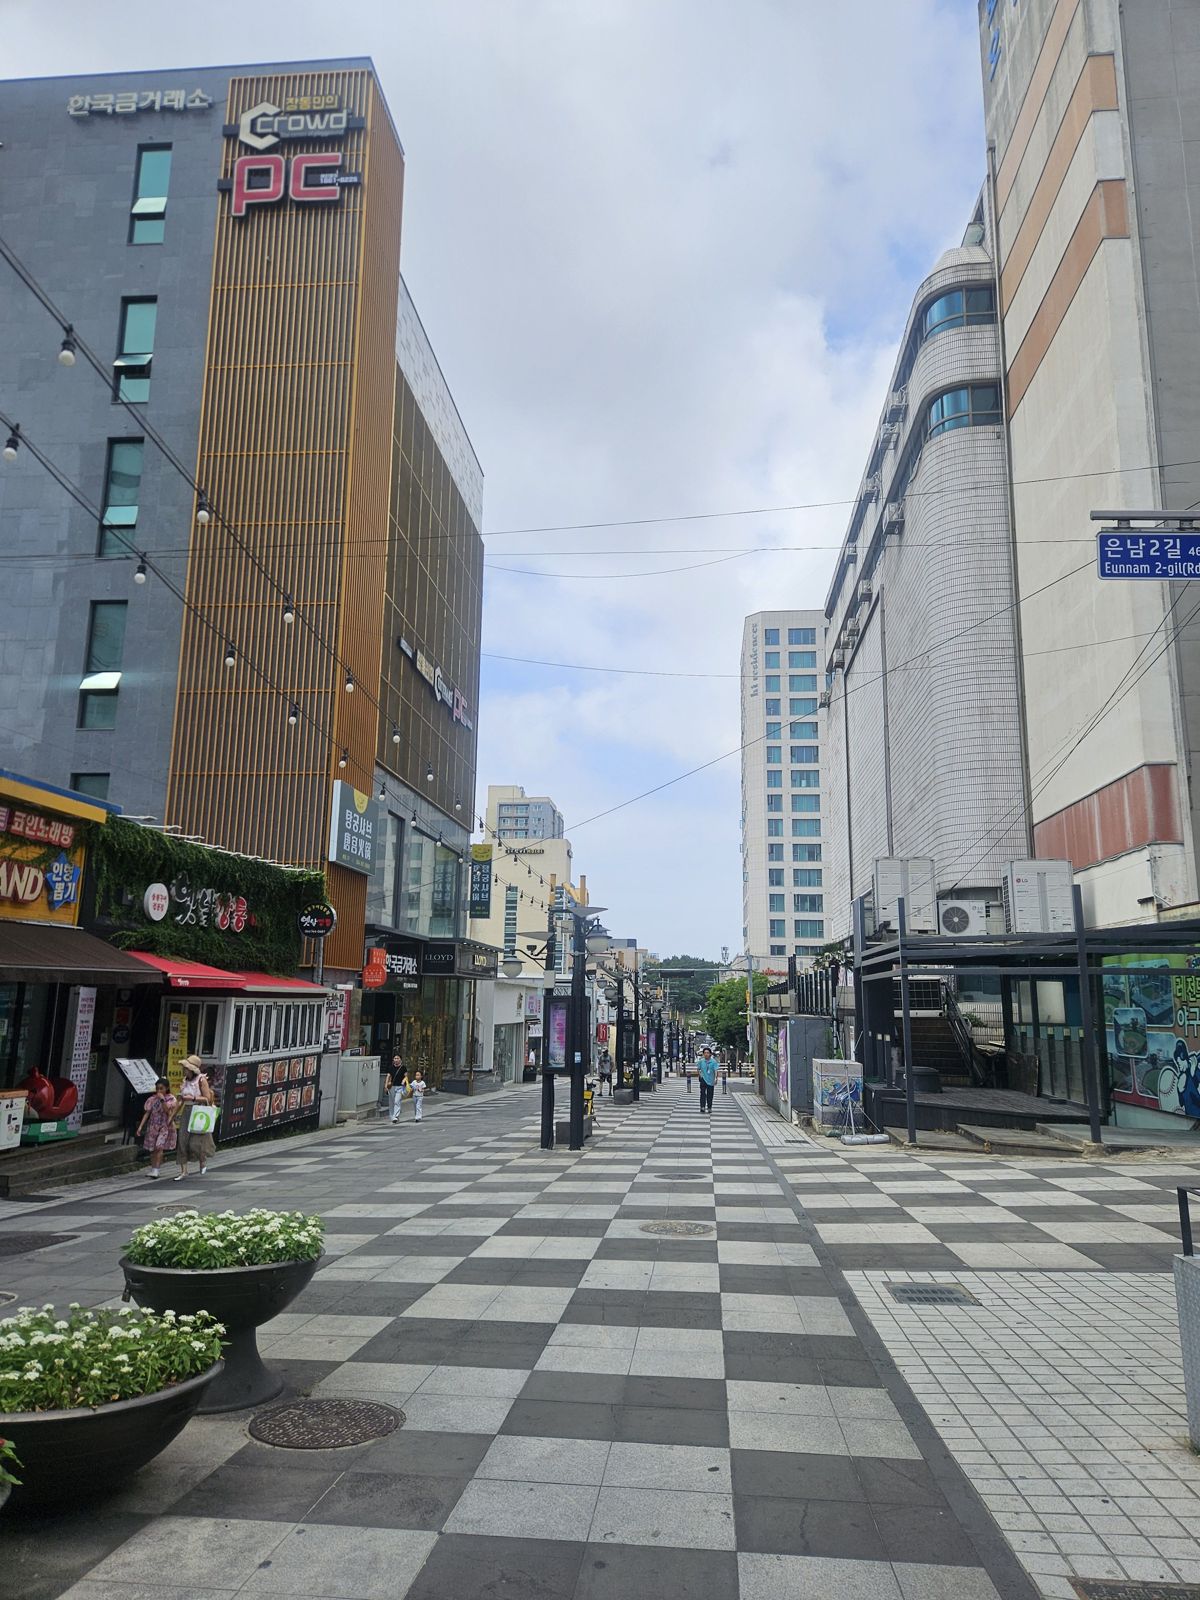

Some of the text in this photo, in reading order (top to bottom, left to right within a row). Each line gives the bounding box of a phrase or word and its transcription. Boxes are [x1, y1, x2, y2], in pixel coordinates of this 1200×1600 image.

[67, 88, 213, 116] 한국금거래소
[285, 95, 338, 111] 장동민의
[1104, 538, 1181, 559] 은남2길
[1105, 562, 1150, 574] Eunnam
[11, 811, 73, 845] 코인노래방
[52, 862, 74, 882] 인형
[53, 881, 76, 901] 뽑기
[384, 952, 418, 975] 한국금거래소
[424, 953, 454, 961] LLOYD
